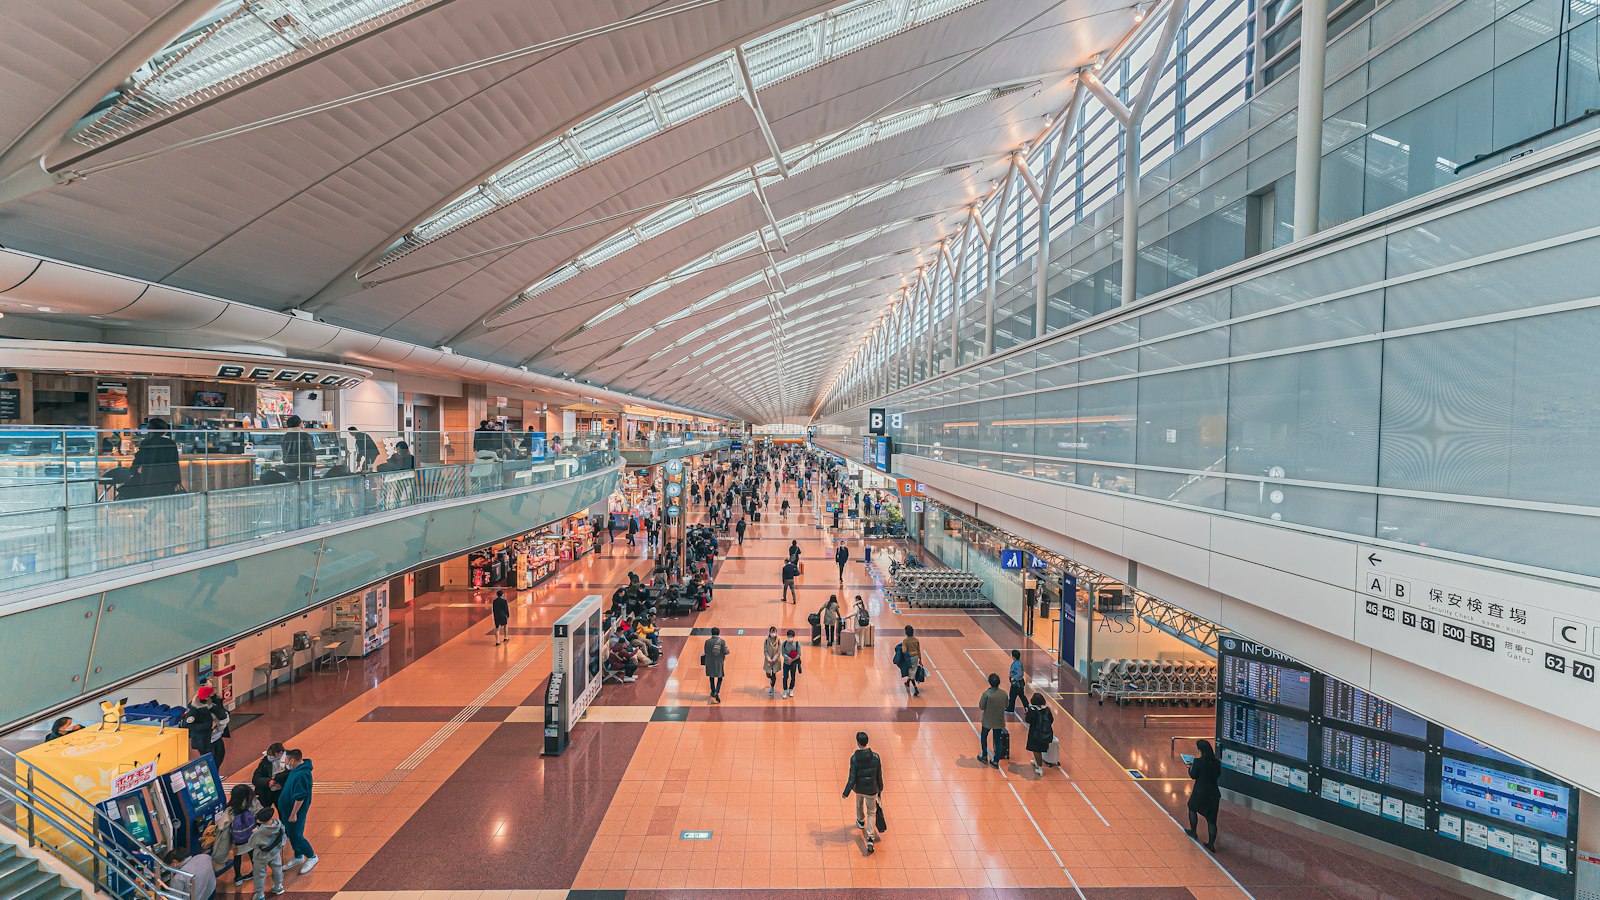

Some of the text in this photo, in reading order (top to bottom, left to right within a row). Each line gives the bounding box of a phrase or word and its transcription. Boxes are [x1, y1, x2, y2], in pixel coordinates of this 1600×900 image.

[217, 364, 319, 383] BEER
[871, 413, 883, 429] B
[670, 461, 677, 471] 4
[905, 483, 912, 493] B
[1371, 578, 1382, 592] A
[1395, 583, 1405, 597] B
[1428, 604, 1475, 621] Security Check
[1429, 587, 1527, 625] 保安検査場
[1366, 603, 1494, 649] 46 48 51 61 500 513
[1561, 625, 1577, 644] C
[1504, 641, 1534, 656] 搭乗口
[1506, 651, 1531, 664] Gates
[1546, 656, 1593, 679] 62 70
[115, 764, 153, 787] ポケモン
